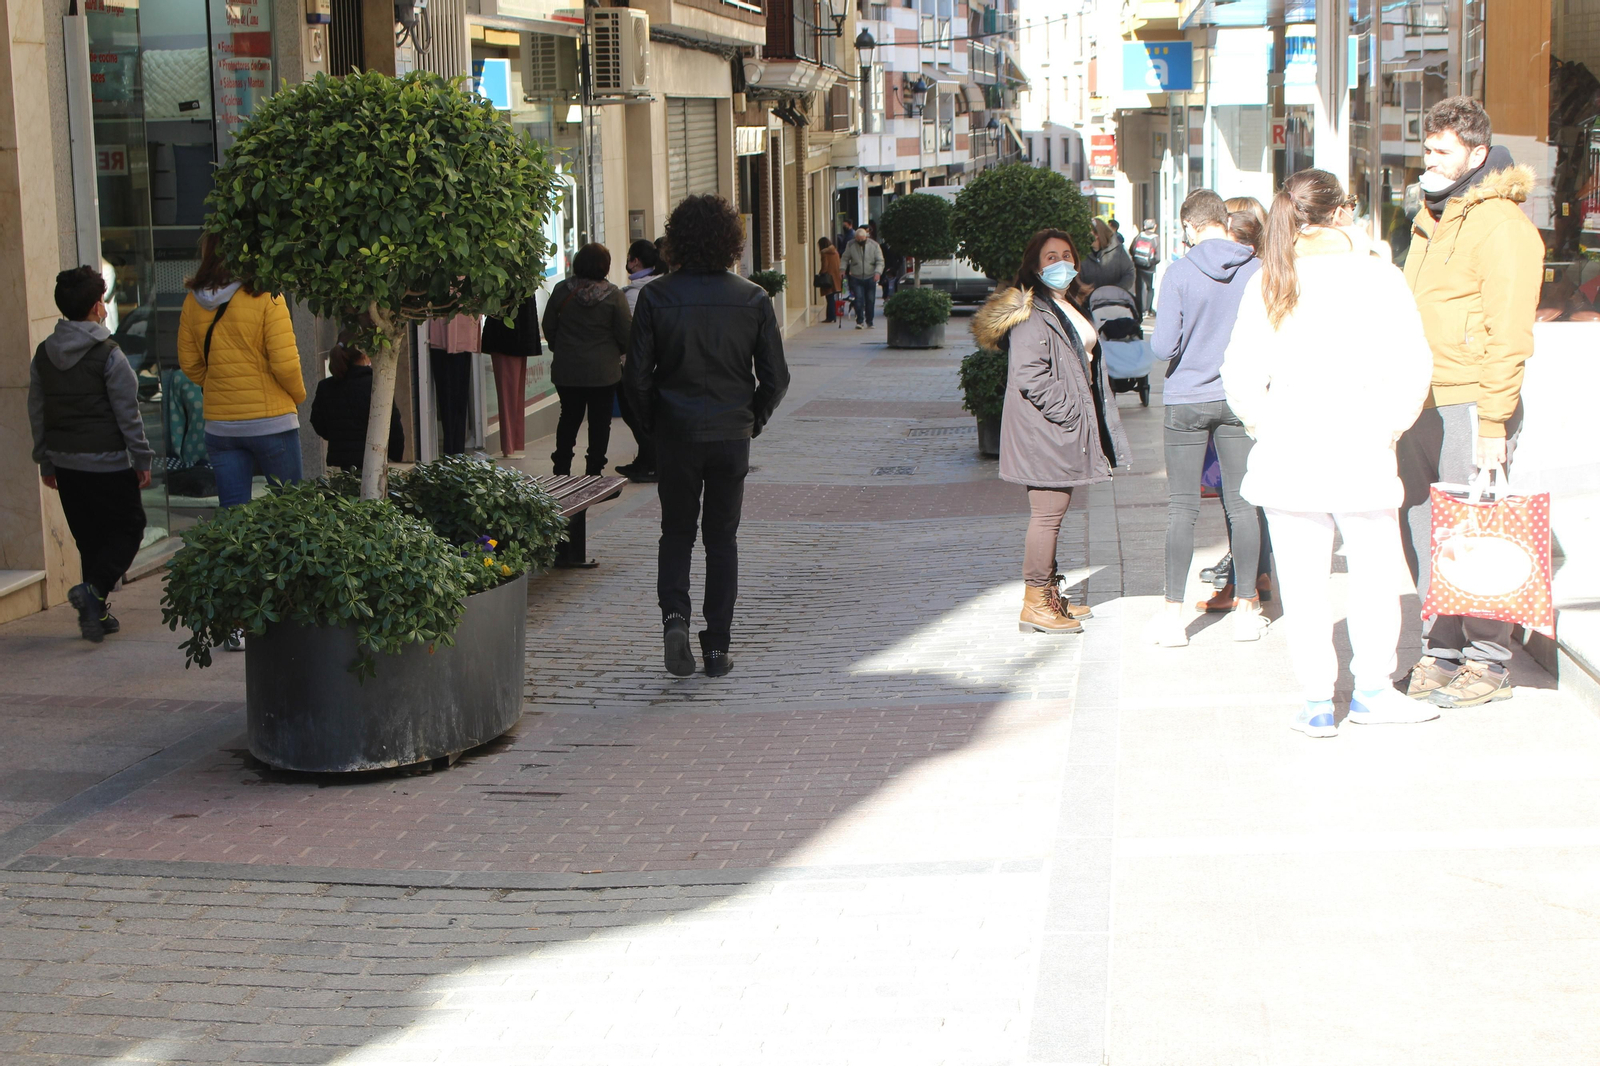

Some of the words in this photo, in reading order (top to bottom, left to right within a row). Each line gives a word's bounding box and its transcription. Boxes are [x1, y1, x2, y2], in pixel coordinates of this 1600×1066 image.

[99, 51, 118, 63] cocina
[222, 58, 250, 71] Protectores
[223, 76, 243, 88] Sábanas
[247, 77, 265, 88] Mantas
[224, 94, 243, 106] Colchas
